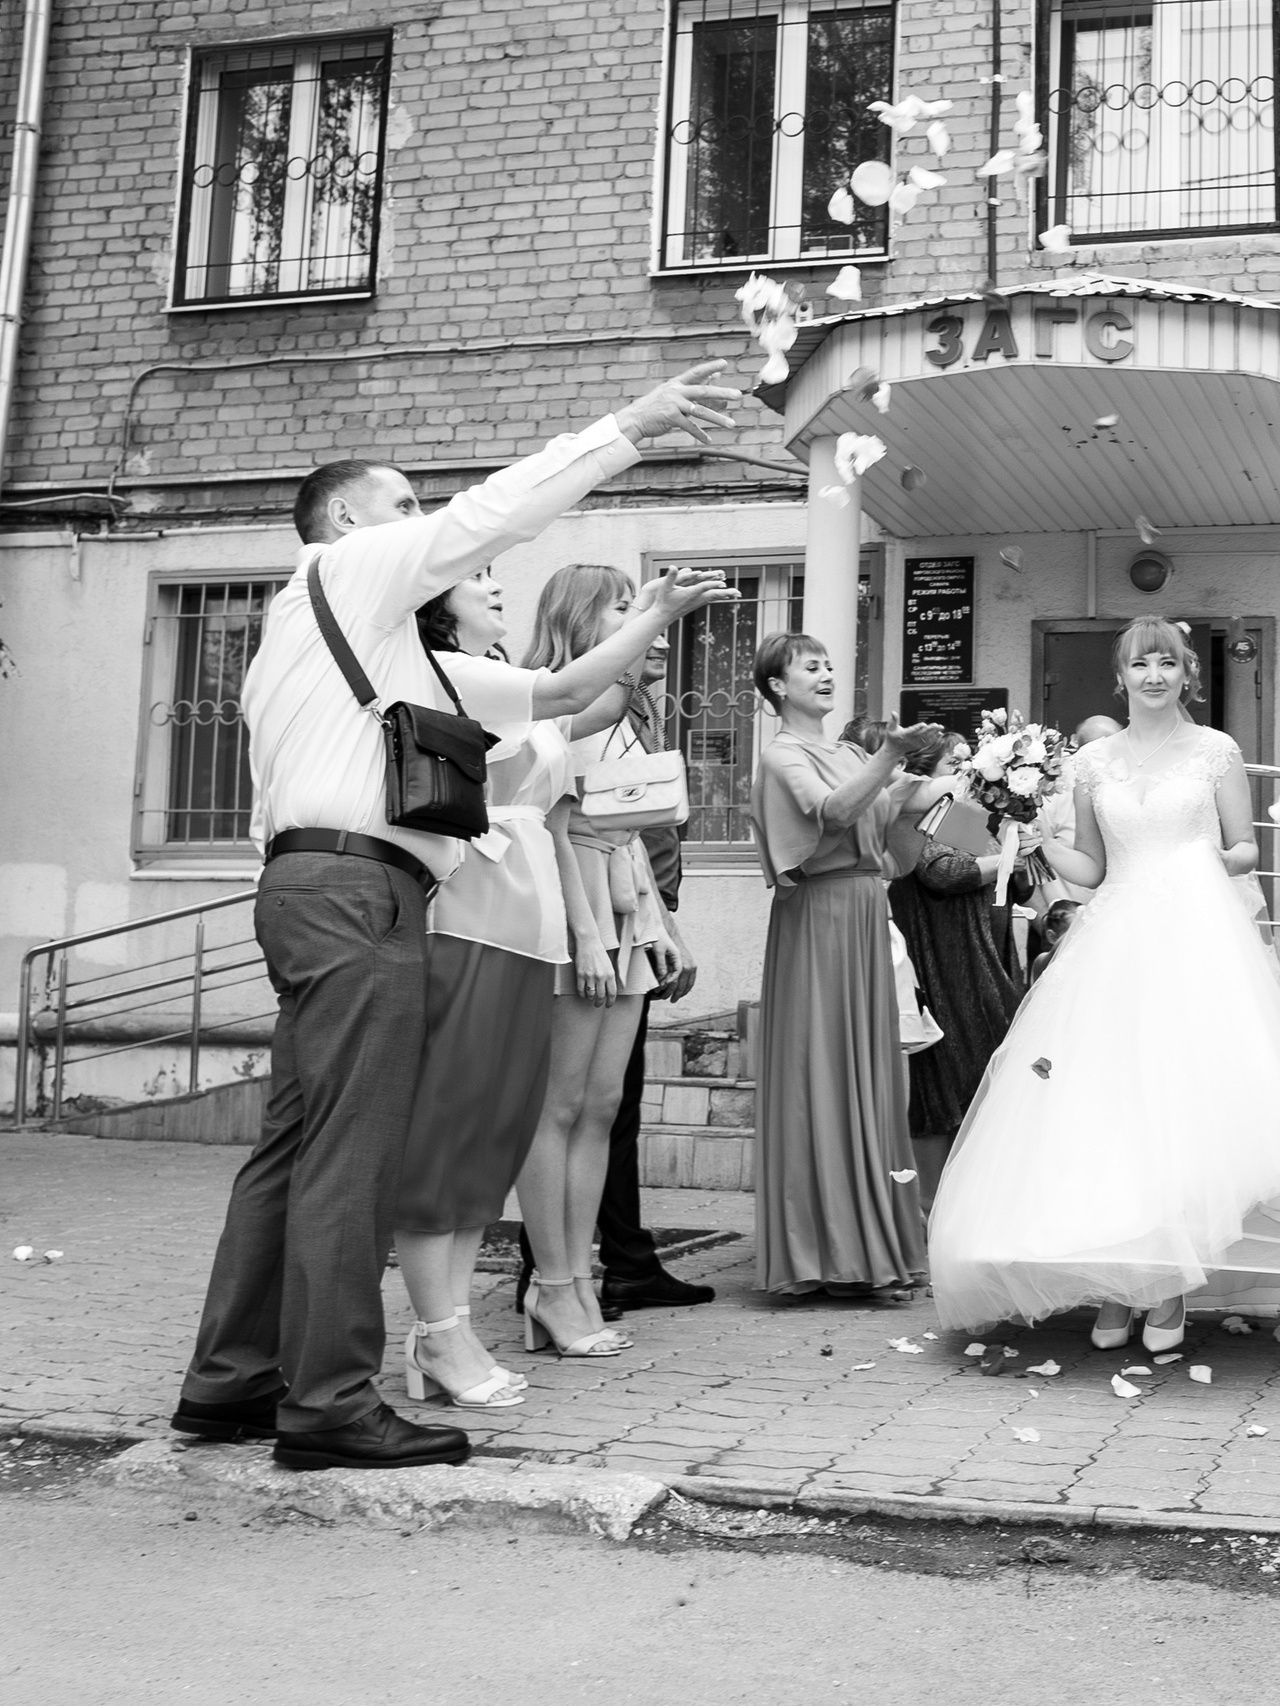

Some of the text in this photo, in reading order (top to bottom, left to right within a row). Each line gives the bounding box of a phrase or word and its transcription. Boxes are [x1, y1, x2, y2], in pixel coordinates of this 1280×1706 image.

[925, 308, 1134, 368] ЗАГС
[919, 560, 960, 569] ОТДЕЛ ЗАГС
[938, 612, 950, 621] до
